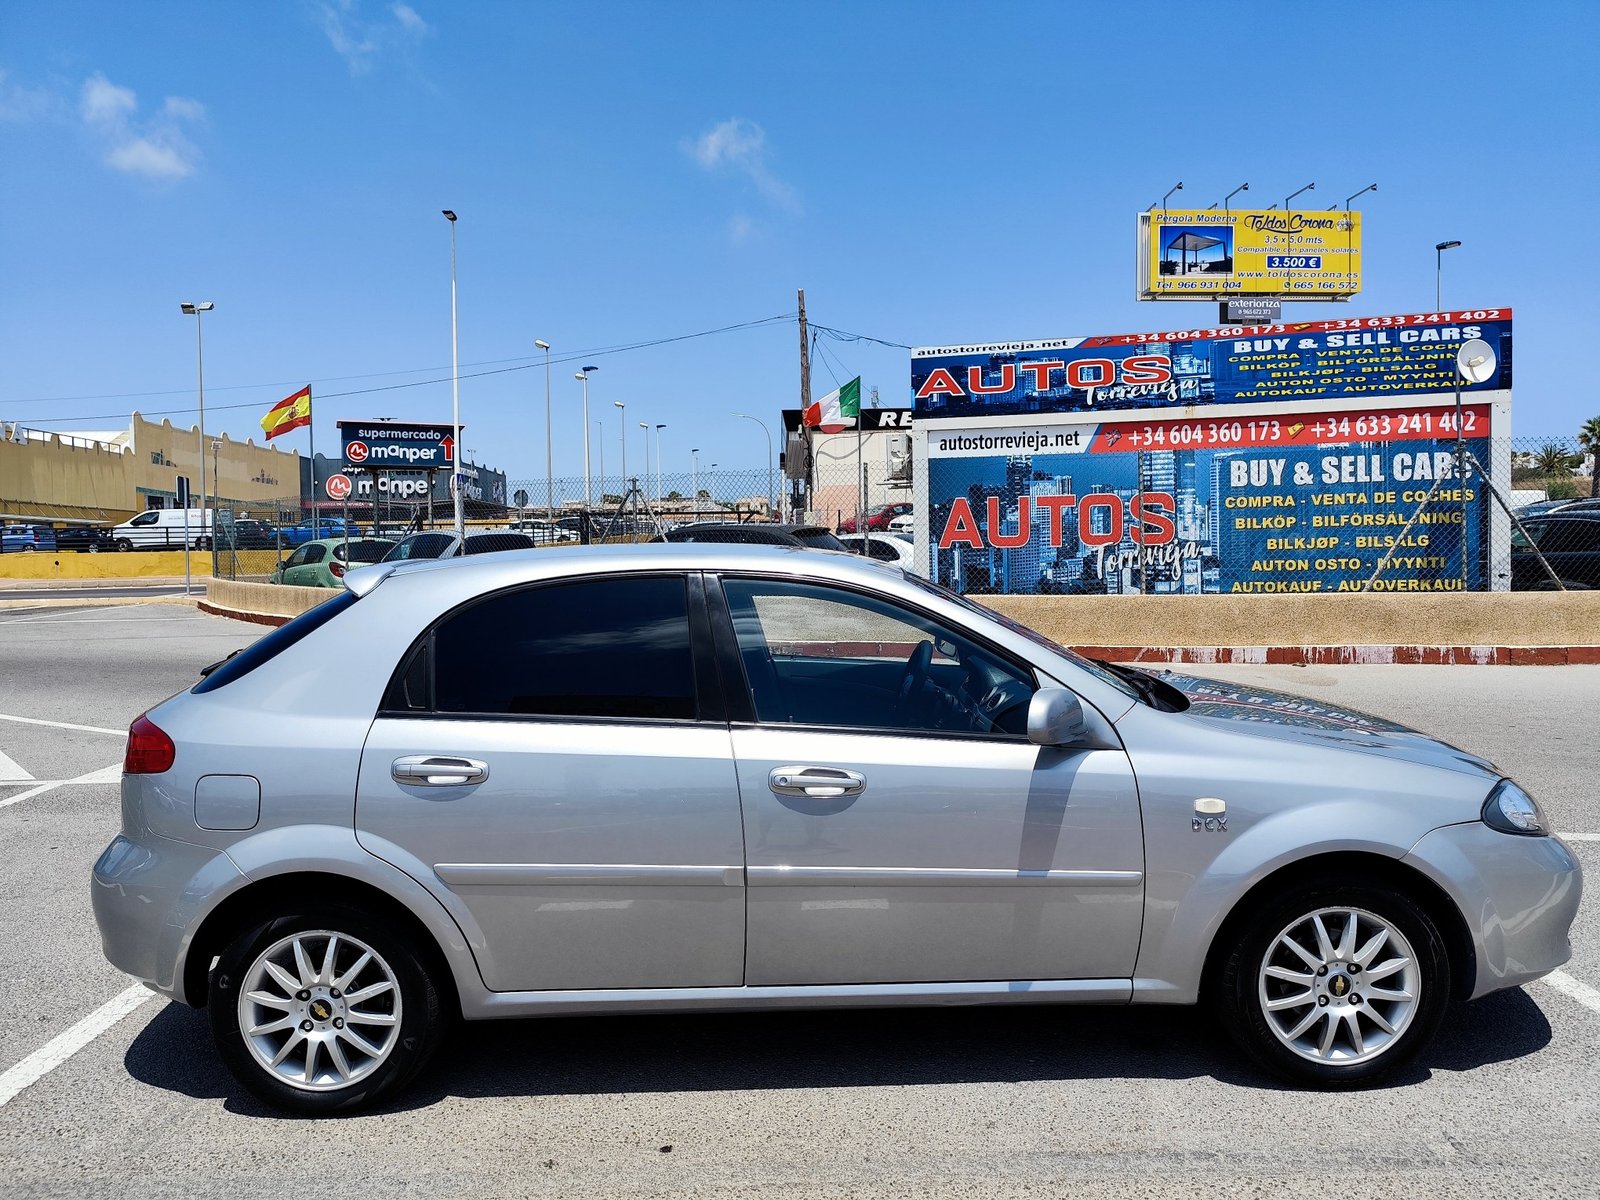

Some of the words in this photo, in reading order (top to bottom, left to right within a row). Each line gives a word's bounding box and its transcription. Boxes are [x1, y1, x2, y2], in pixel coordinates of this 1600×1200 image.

[1196, 214, 1237, 223] Moderna
[1244, 214, 1287, 233] Toldos
[1289, 214, 1335, 229] Corona
[1271, 257, 1306, 268] 3.500
[1308, 258, 1317, 268] €
[1237, 270, 1359, 279] www.toldoscorona.es
[1156, 281, 1173, 289] Tel.
[1177, 281, 1198, 289] 966
[1199, 281, 1219, 289] 931
[1222, 281, 1242, 289] 004
[1228, 299, 1280, 308] exterioriza
[1318, 319, 1361, 330] +34
[1367, 316, 1406, 327] 633
[1413, 313, 1451, 323] 241
[1459, 310, 1500, 320] 402
[1121, 332, 1160, 343] +34
[1165, 330, 1201, 340] 604
[1207, 327, 1243, 337] 360
[1250, 324, 1286, 334] 173
[1234, 338, 1290, 353] BUY
[1297, 338, 1318, 349] &
[1326, 332, 1391, 348] SELL
[1399, 326, 1482, 343] CARS
[917, 340, 1067, 356] autostorrevieja.net
[1228, 353, 1299, 362] COMPRA
[1316, 348, 1373, 357] VENTA
[1239, 361, 1301, 371] BILKÖP
[1271, 368, 1344, 378] BILKJØP
[1361, 363, 1437, 373] BILSALG
[914, 355, 1172, 398] AUTOS
[1256, 379, 1314, 388] AUTON
[1320, 376, 1366, 384] OSTO
[1383, 371, 1454, 381] MYYNTI
[1081, 378, 1198, 405] Torrevieja
[1235, 387, 1326, 398] AUTOKAUF
[1310, 417, 1350, 438] +34
[1355, 415, 1391, 436] 633
[1397, 412, 1432, 434] 241
[358, 429, 441, 440] supermercado
[1128, 426, 1165, 446] +34
[1169, 424, 1203, 445] 604
[1208, 422, 1242, 443] 360
[1247, 420, 1281, 441] 173
[939, 430, 1080, 452] autostorrevieja.net
[371, 444, 437, 463] manper
[1230, 459, 1286, 487] BUY
[1293, 461, 1314, 486] &
[1321, 454, 1385, 485] SELL
[1225, 495, 1296, 508] COMPRA
[1311, 493, 1368, 506] VENTA
[1374, 492, 1396, 504] DE
[938, 492, 1176, 549] AUTOS
[1235, 514, 1297, 529] BILKÖP
[1267, 536, 1340, 550] BILKJØP
[1251, 559, 1309, 571] AUTON
[1315, 558, 1361, 570] OSTO
[1231, 580, 1322, 593] AUTOKAUF
[1192, 817, 1228, 831] DCX
